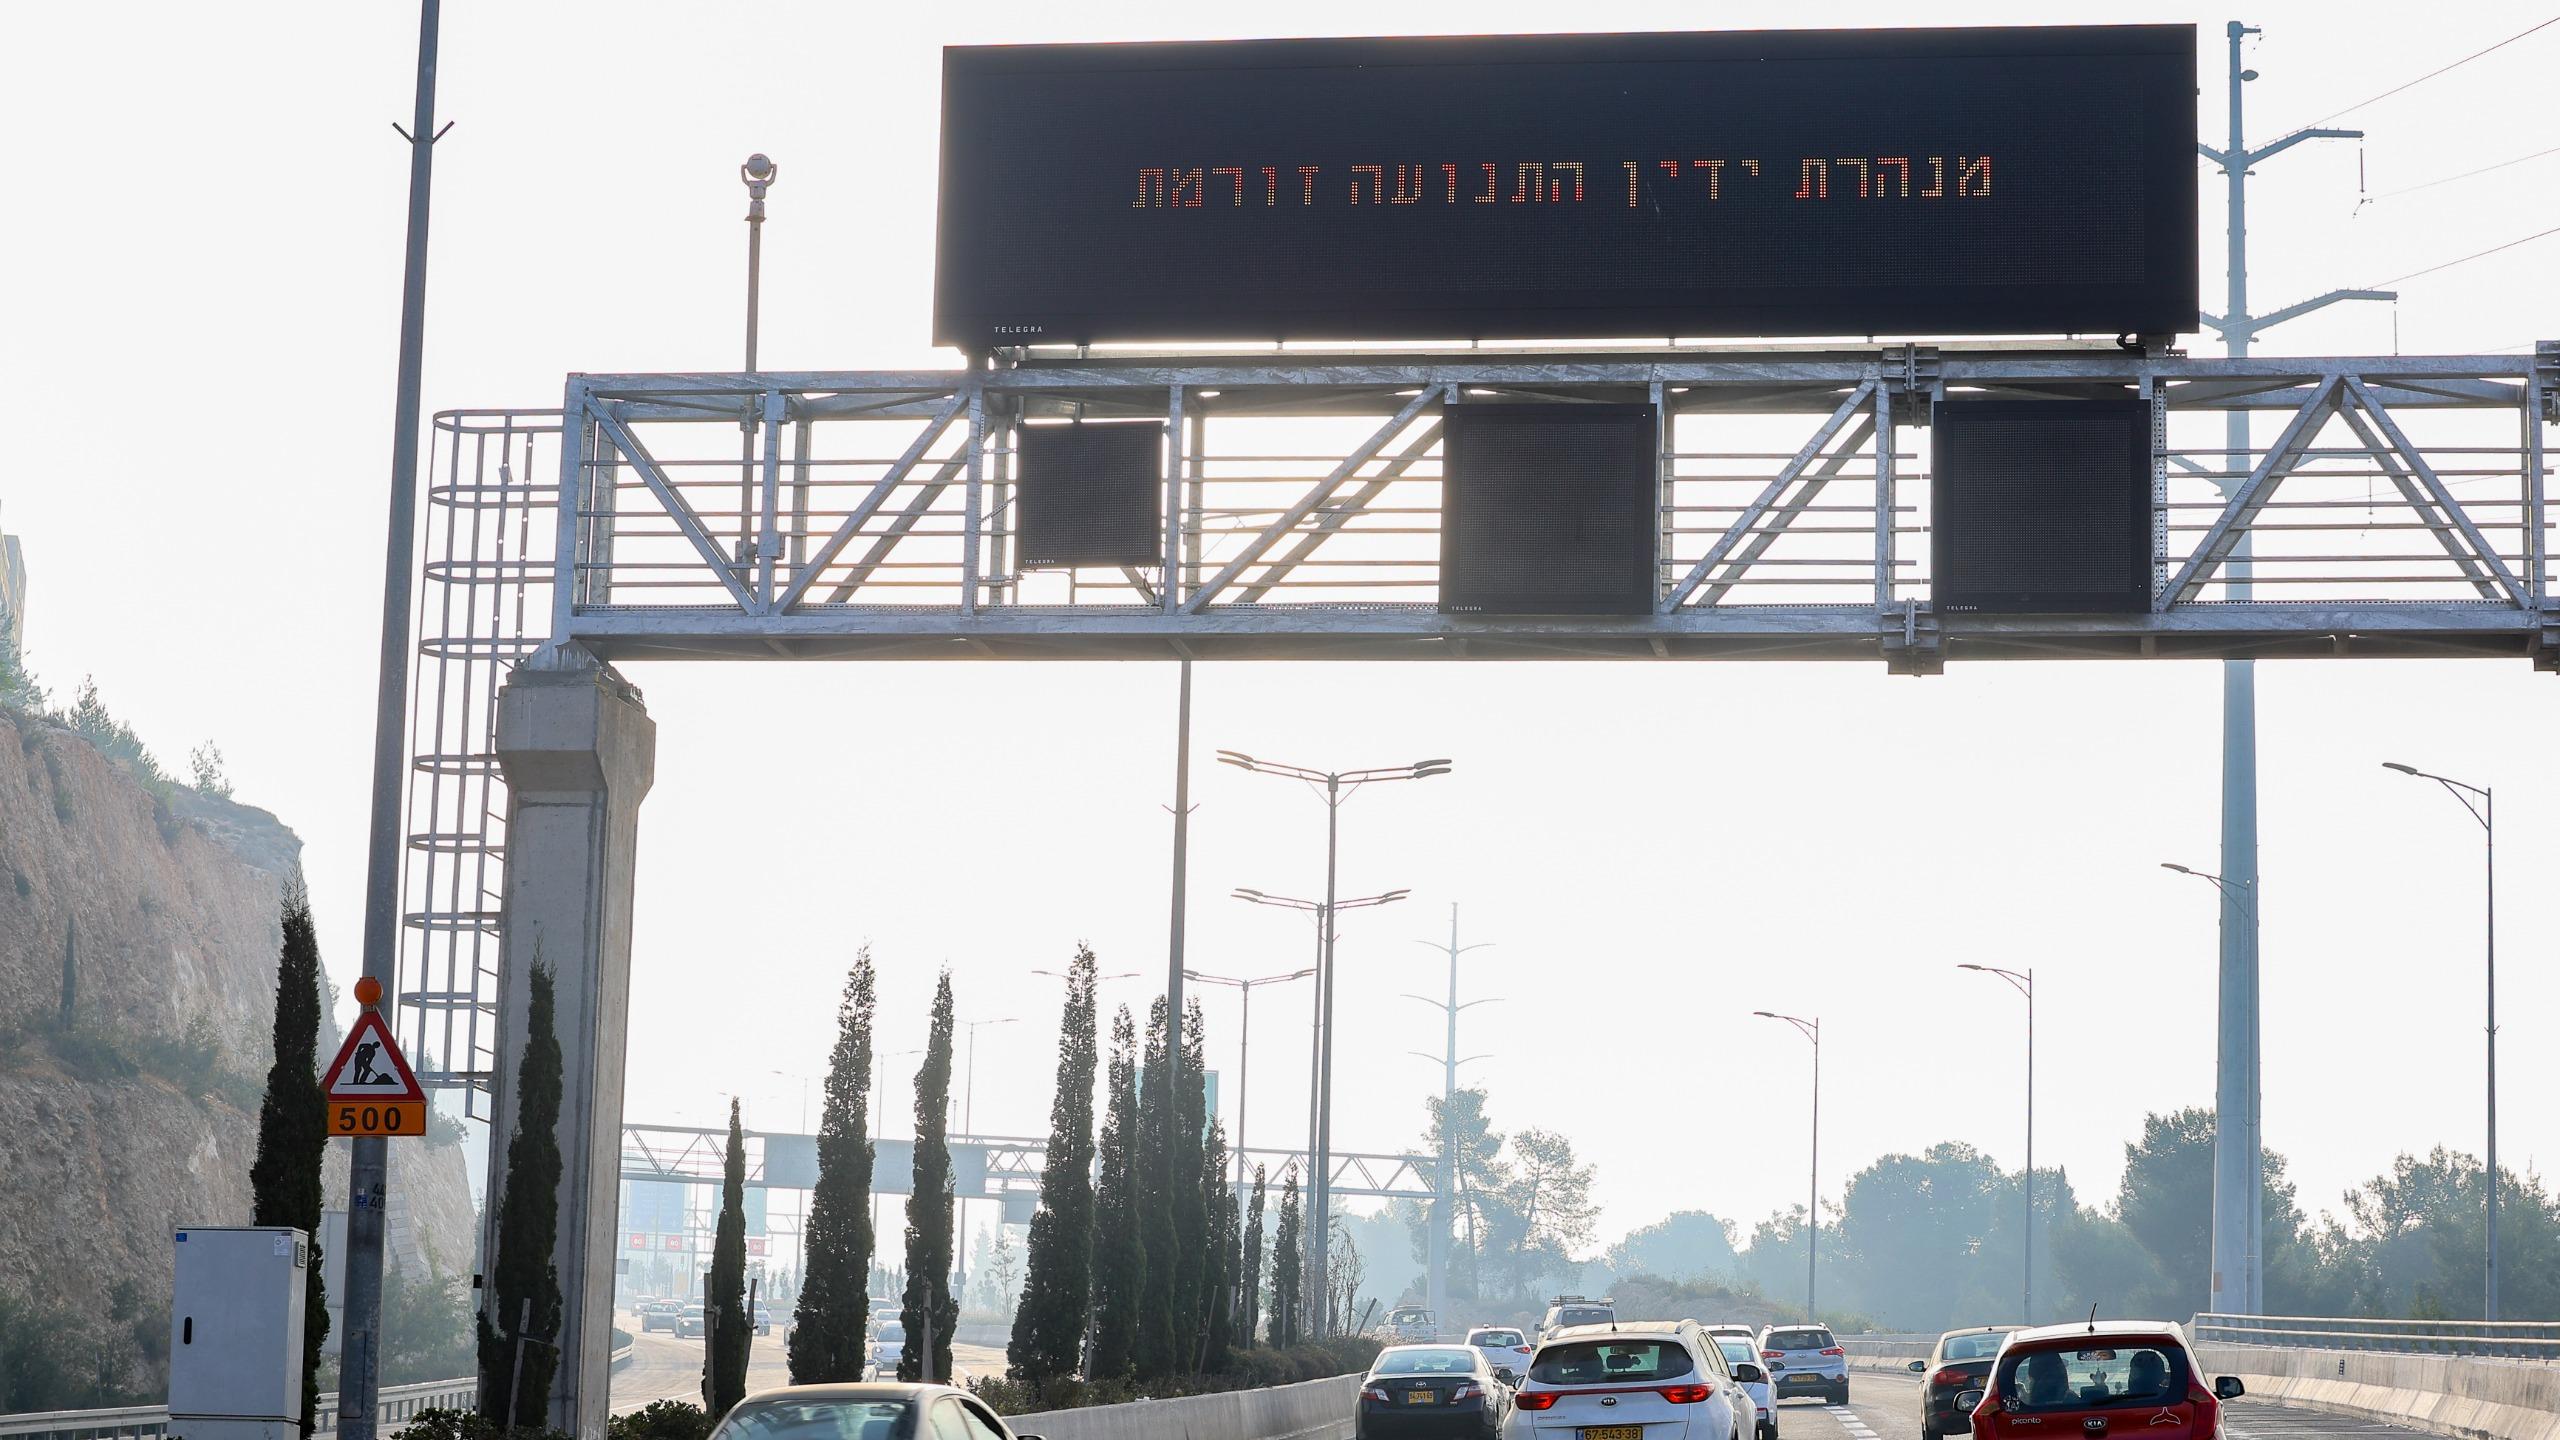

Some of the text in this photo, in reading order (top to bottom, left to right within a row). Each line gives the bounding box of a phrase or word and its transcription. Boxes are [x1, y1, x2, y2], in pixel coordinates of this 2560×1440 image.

[1131, 155, 1992, 209] מנהרת ידין התנועה זורמת
[339, 1106, 401, 1131] 500
